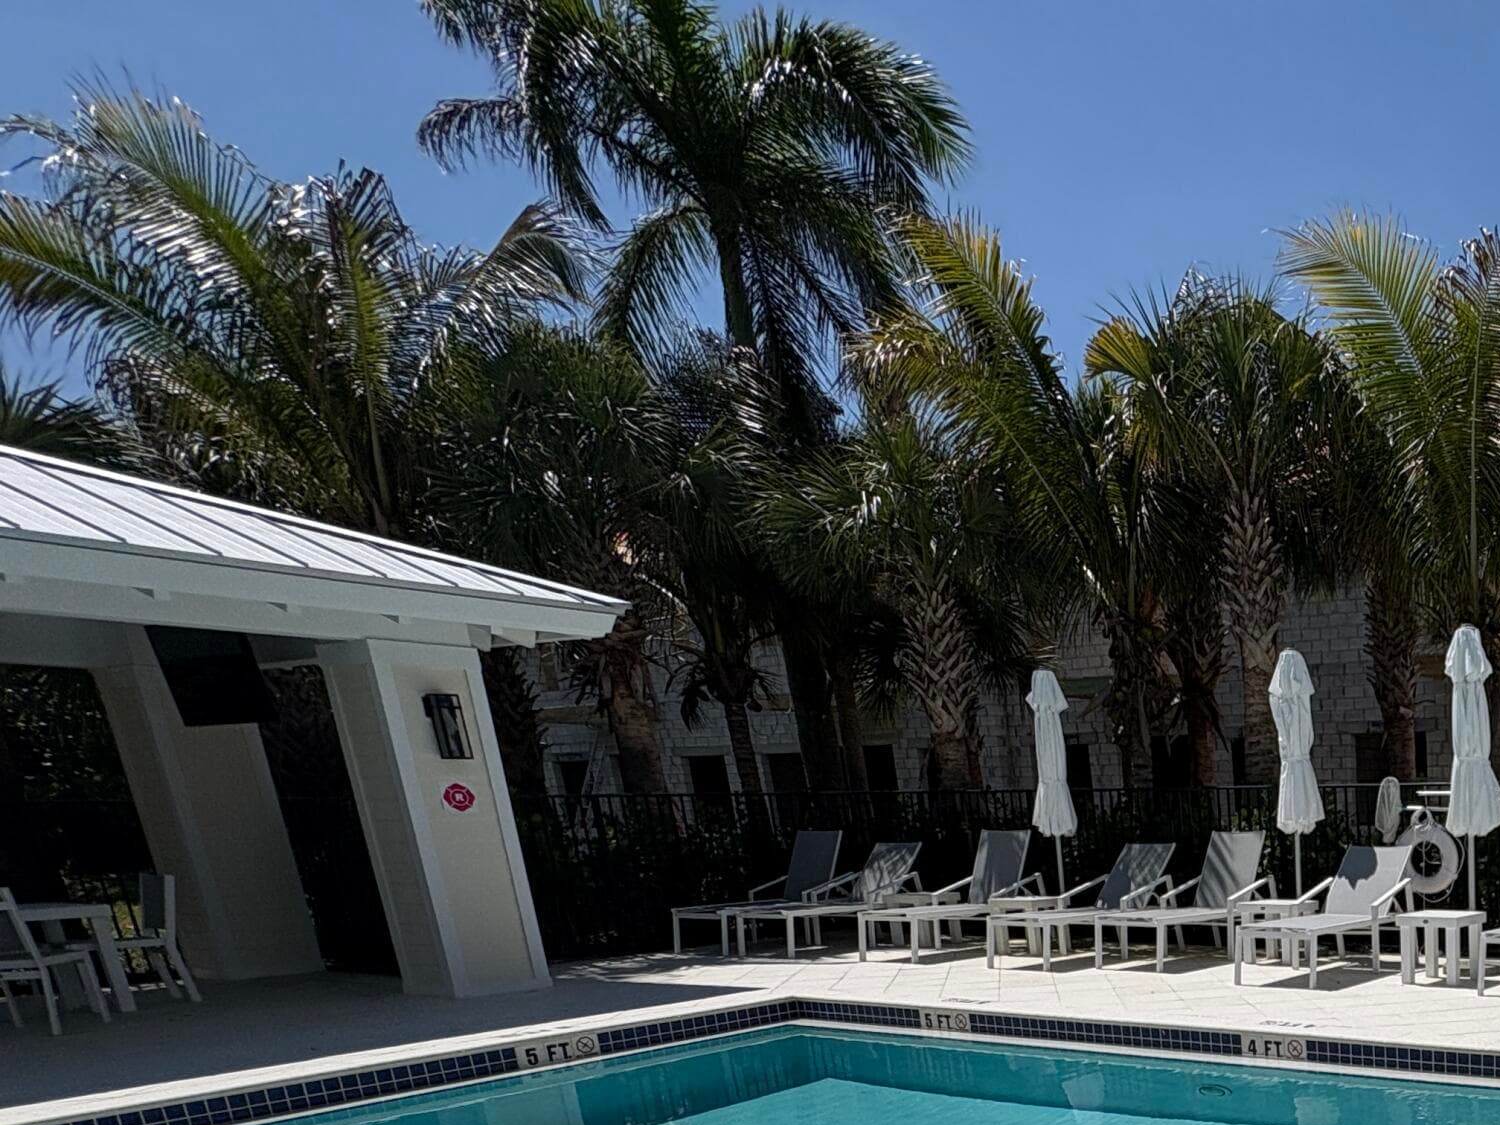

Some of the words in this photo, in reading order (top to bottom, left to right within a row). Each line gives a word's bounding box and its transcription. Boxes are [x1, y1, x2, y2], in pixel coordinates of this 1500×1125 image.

[924, 1013, 933, 1028] 5
[1248, 1039, 1257, 1056] 4
[525, 1047, 539, 1066] 5
